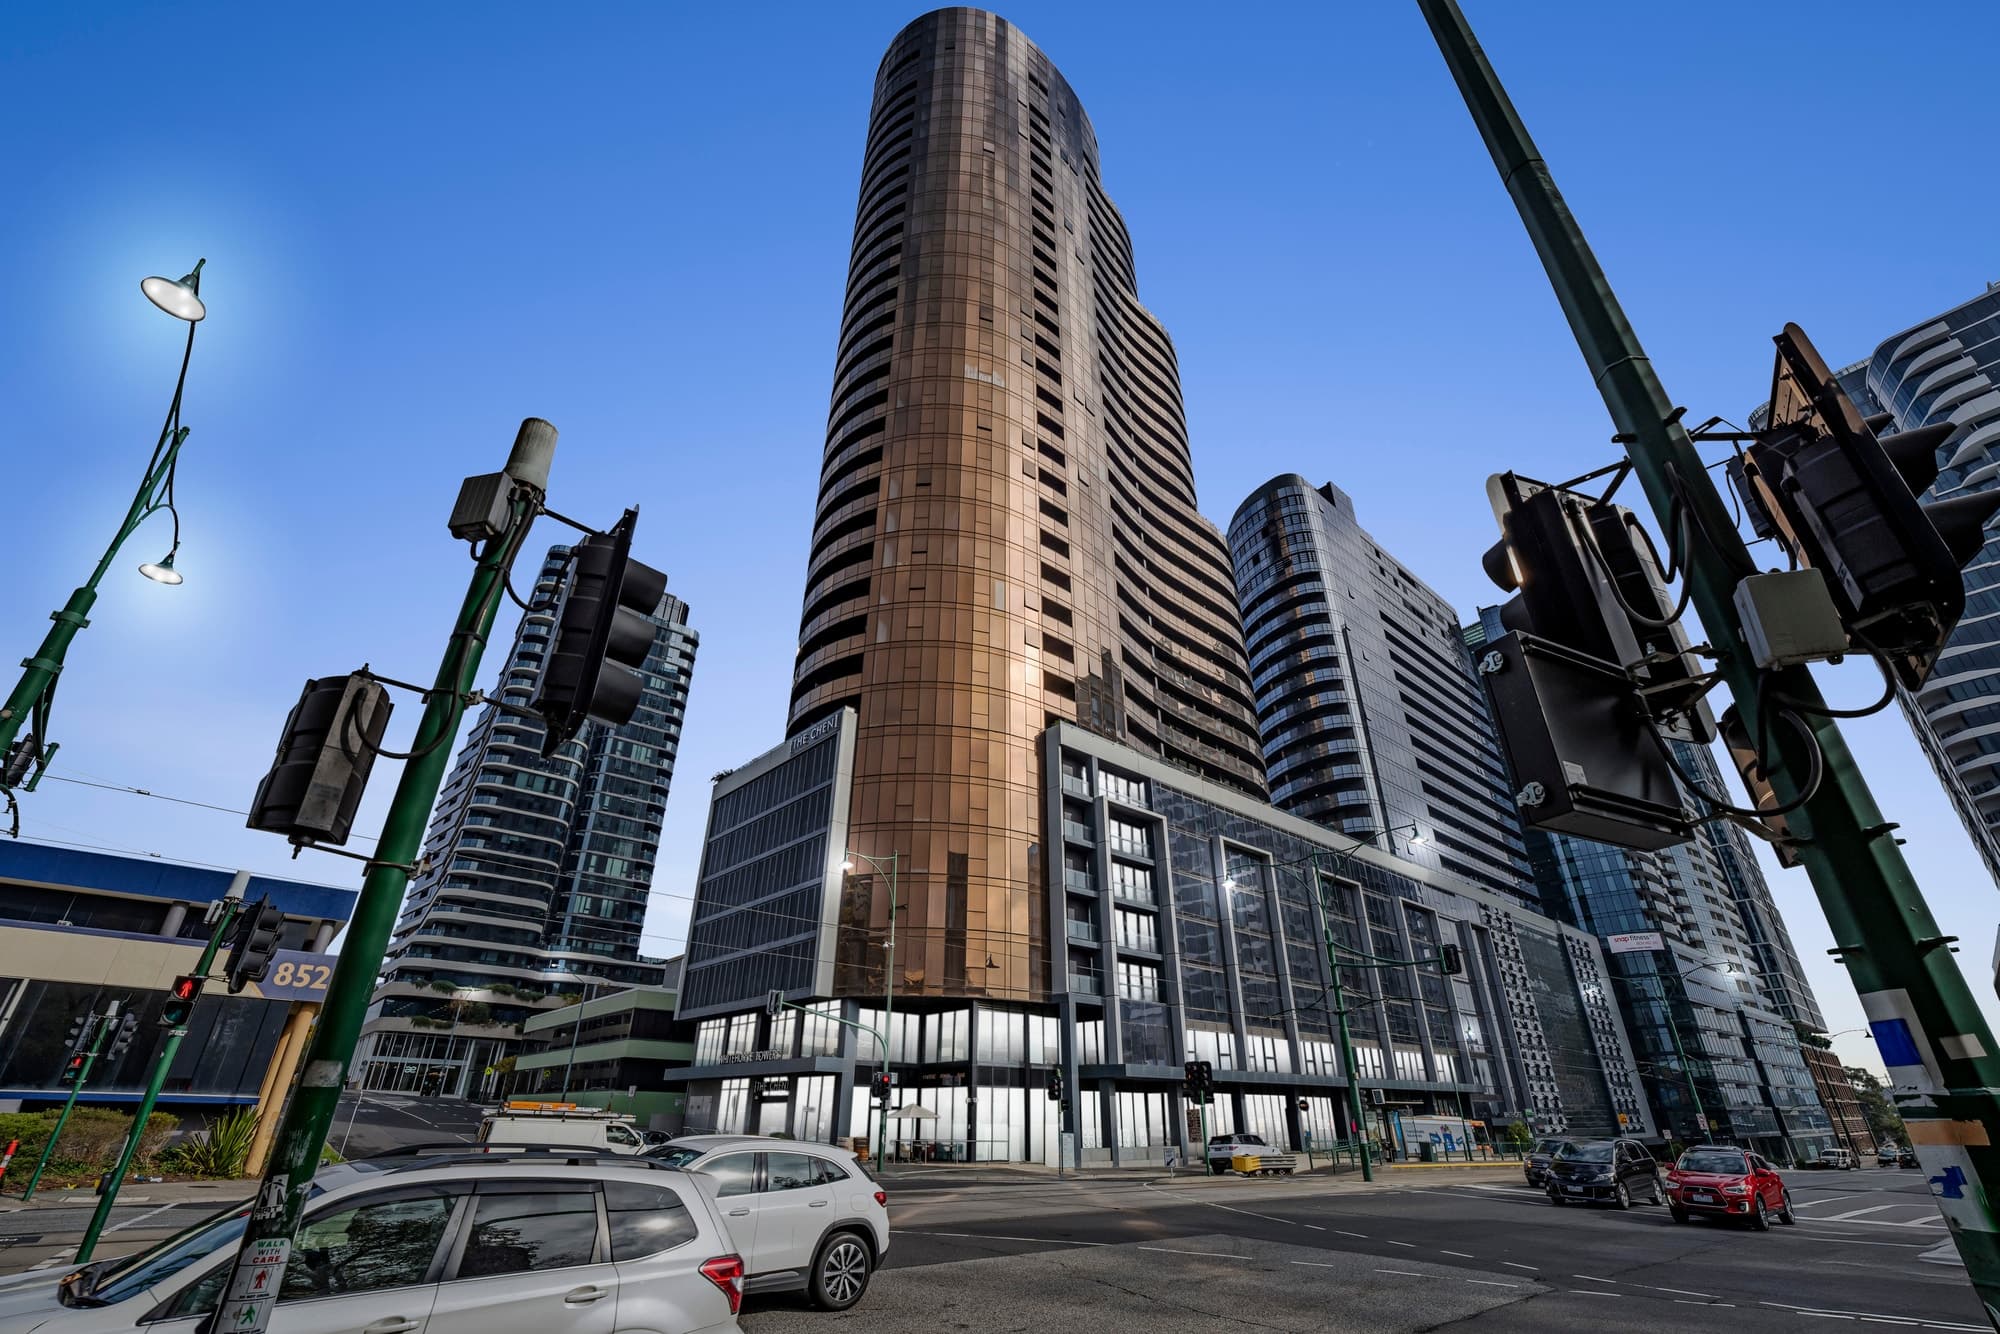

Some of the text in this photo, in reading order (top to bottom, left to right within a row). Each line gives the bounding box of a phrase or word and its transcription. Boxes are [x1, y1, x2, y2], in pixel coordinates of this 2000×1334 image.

[793, 733, 809, 750] THE
[273, 962, 331, 990] 852
[257, 1240, 285, 1248] WALK
[258, 1248, 280, 1256] WITH
